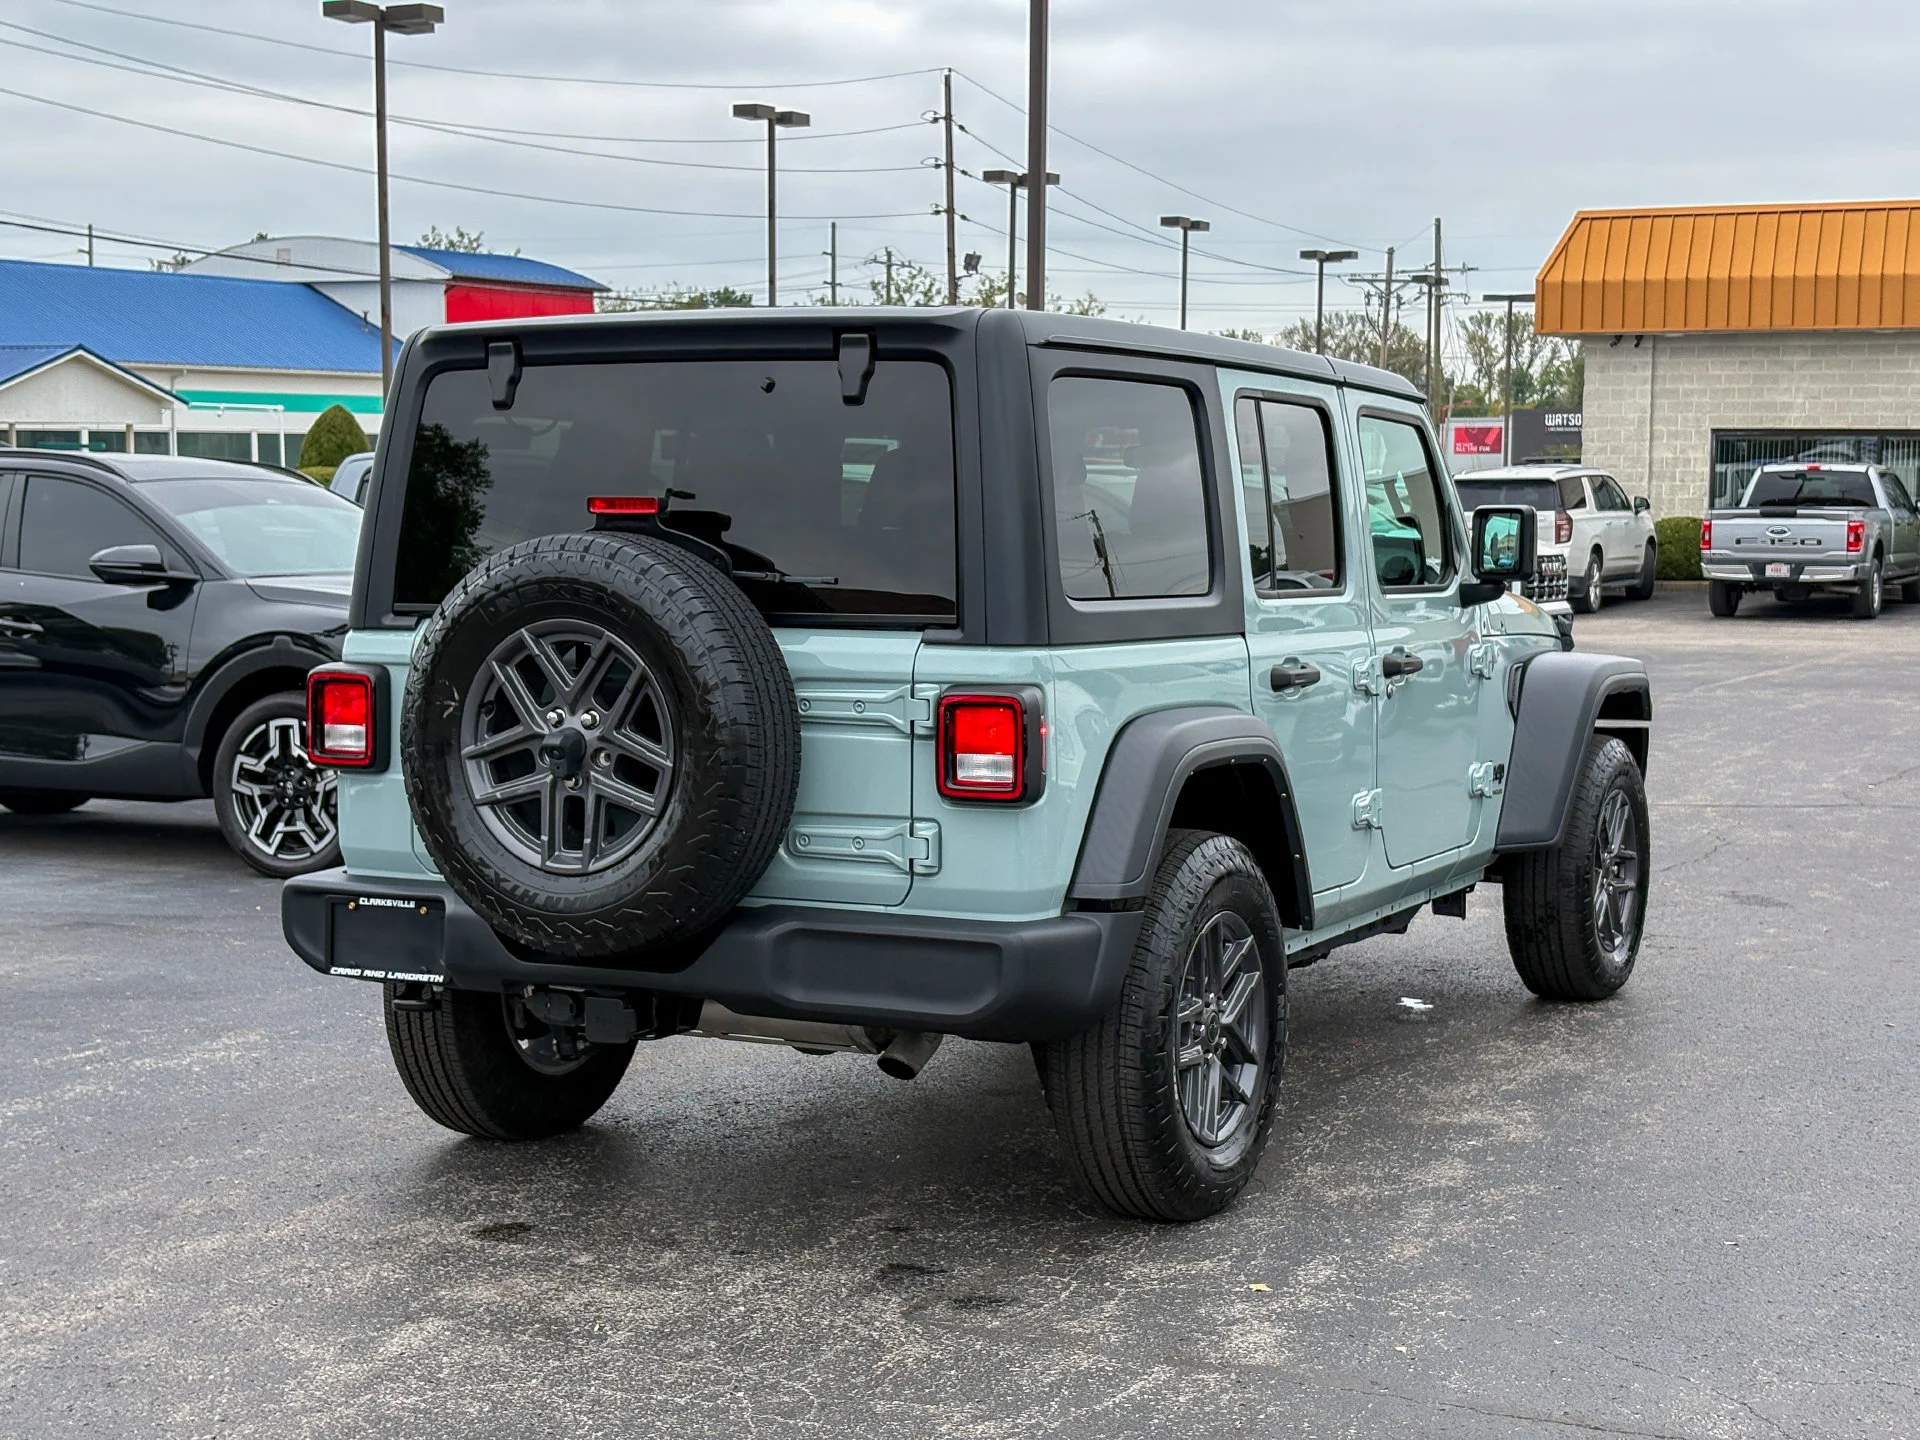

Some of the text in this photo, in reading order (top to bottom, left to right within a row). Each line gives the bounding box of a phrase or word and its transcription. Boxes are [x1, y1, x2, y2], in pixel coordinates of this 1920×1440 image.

[1545, 413, 1582, 426] WATSO
[359, 897, 416, 908] CLARKSVILLE
[363, 969, 386, 979] AND
[387, 971, 444, 983] LANDRETH
